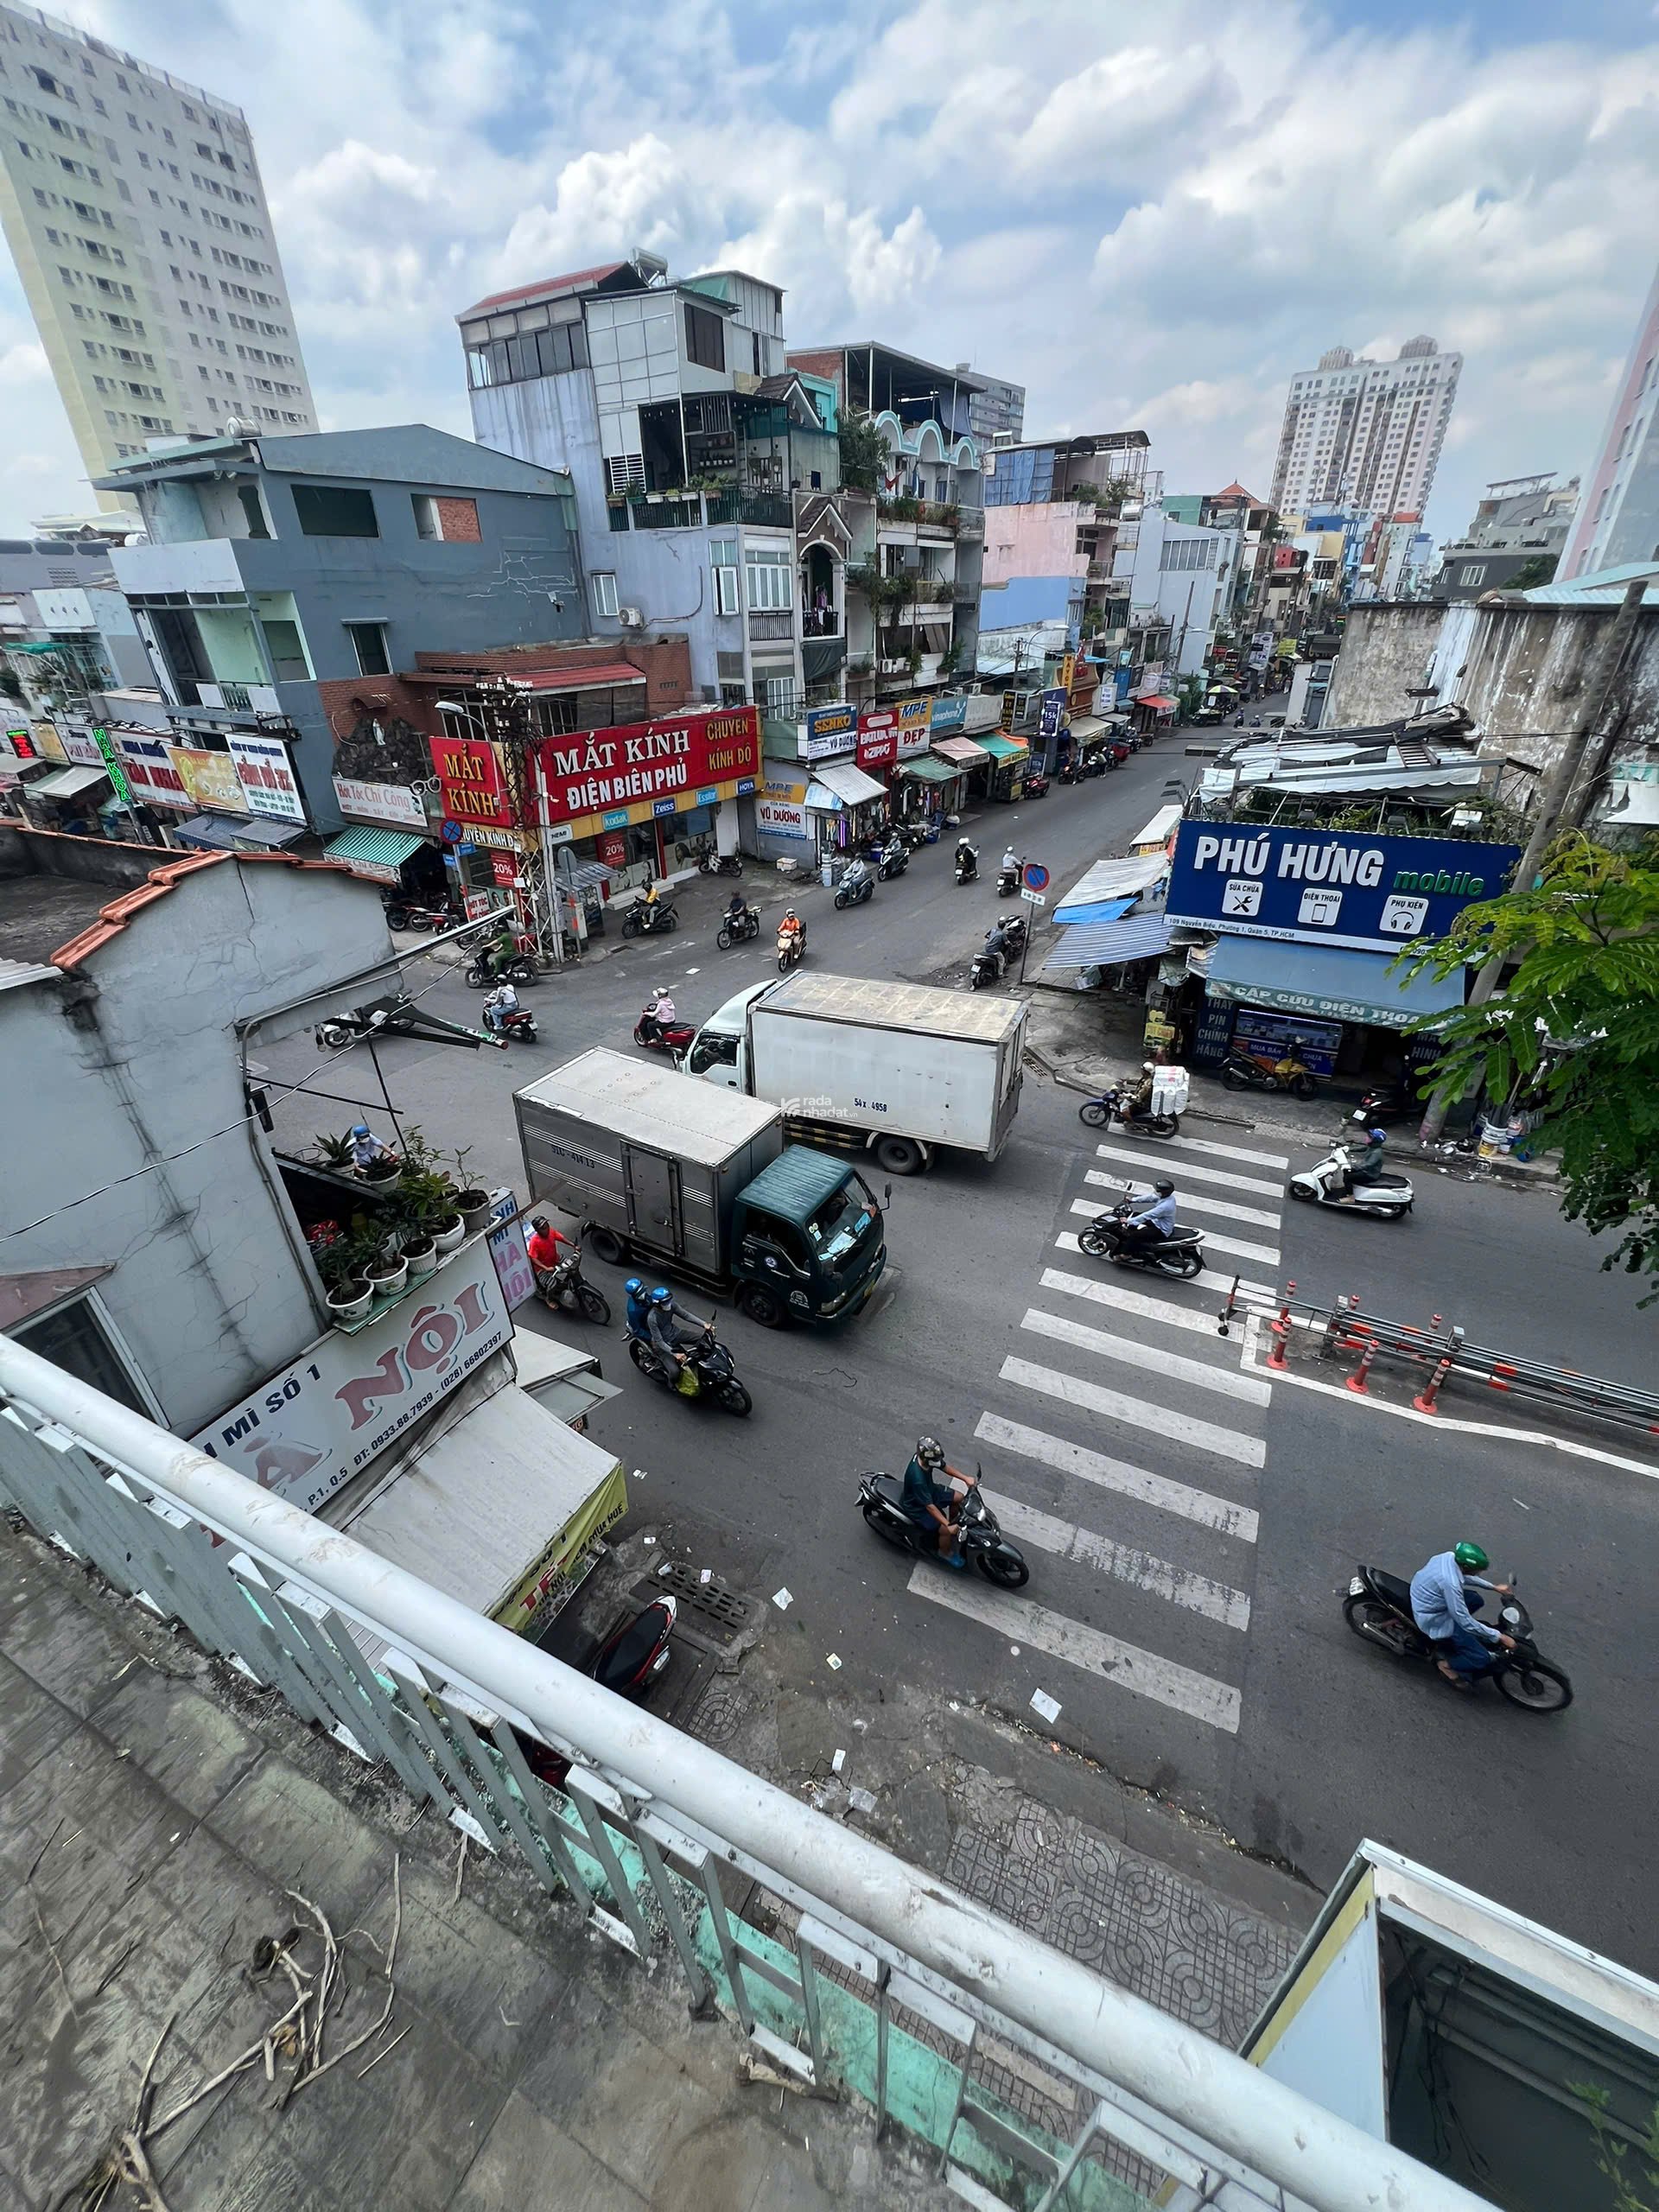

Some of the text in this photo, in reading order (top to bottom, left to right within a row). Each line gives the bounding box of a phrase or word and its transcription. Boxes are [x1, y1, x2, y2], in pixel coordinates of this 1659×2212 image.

[707, 715, 748, 741] CHUYÊN
[93, 728, 131, 802] NHA KHOA
[443, 743, 484, 781] MẮT
[553, 727, 691, 777] MẮT KÍNH
[709, 742, 752, 771] KÍNH ĐỘ
[567, 757, 688, 810] ĐIỆN BIÊN PHỦ
[739, 781, 754, 791] HOYA
[765, 781, 794, 793] MPE
[447, 782, 497, 817] KÍNH
[760, 806, 771, 819] VŨ
[605, 843, 625, 856] 20%
[1193, 833, 1384, 887] PHÚ HƯNG
[493, 863, 513, 875] 20%
[1393, 869, 1485, 897] mobile
[1235, 986, 1272, 999] CẤP
[1198, 1027, 1229, 1042] CHÍNH
[334, 1282, 493, 1431] NỘI
[221, 1363, 321, 1447] MÌ SỐ 1
[371, 1394, 434, 1452] 0933.88.7939
[440, 1366, 463, 1391] (028)
[464, 1331, 503, 1370] 66802397
